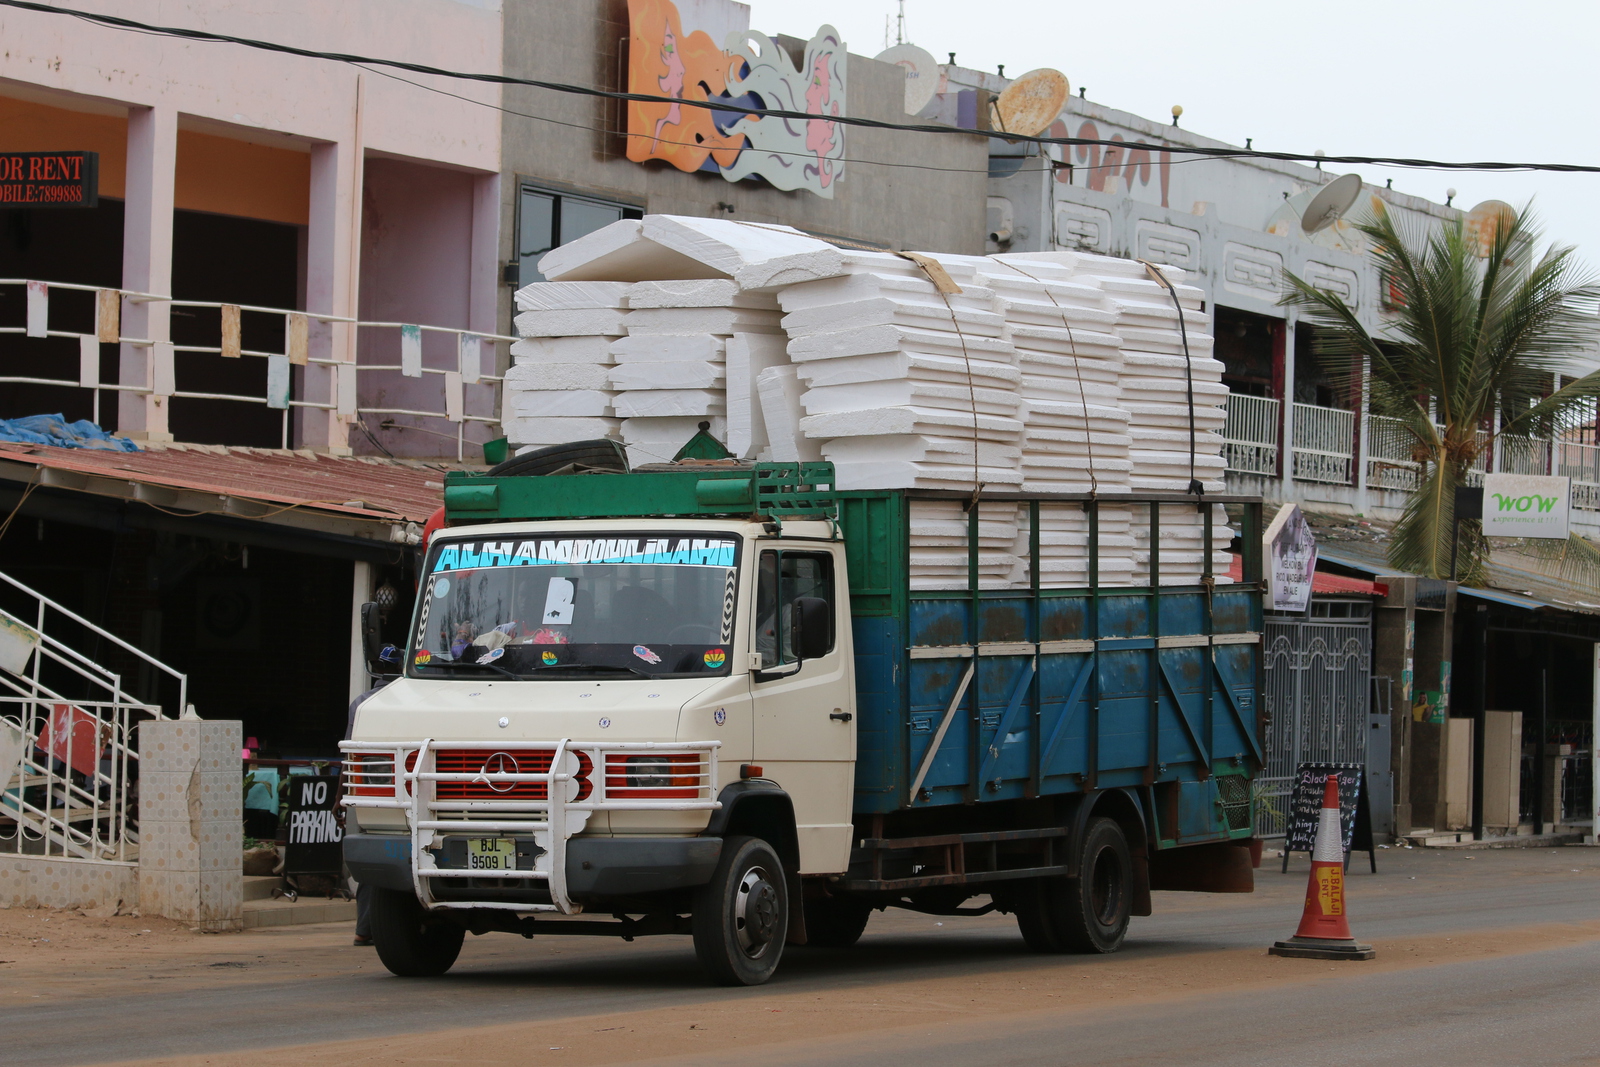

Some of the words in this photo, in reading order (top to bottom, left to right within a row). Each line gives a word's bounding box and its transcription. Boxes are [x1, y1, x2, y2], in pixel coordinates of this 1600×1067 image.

[905, 71, 920, 79] ISH
[28, 156, 84, 181] RENT
[1301, 770, 1329, 784] Black
[301, 781, 327, 806] NO
[1300, 785, 1325, 795] Prawn
[290, 810, 343, 843] PARKING
[481, 838, 501, 852] BJL
[472, 856, 499, 869] 9509
[504, 856, 511, 869] L
